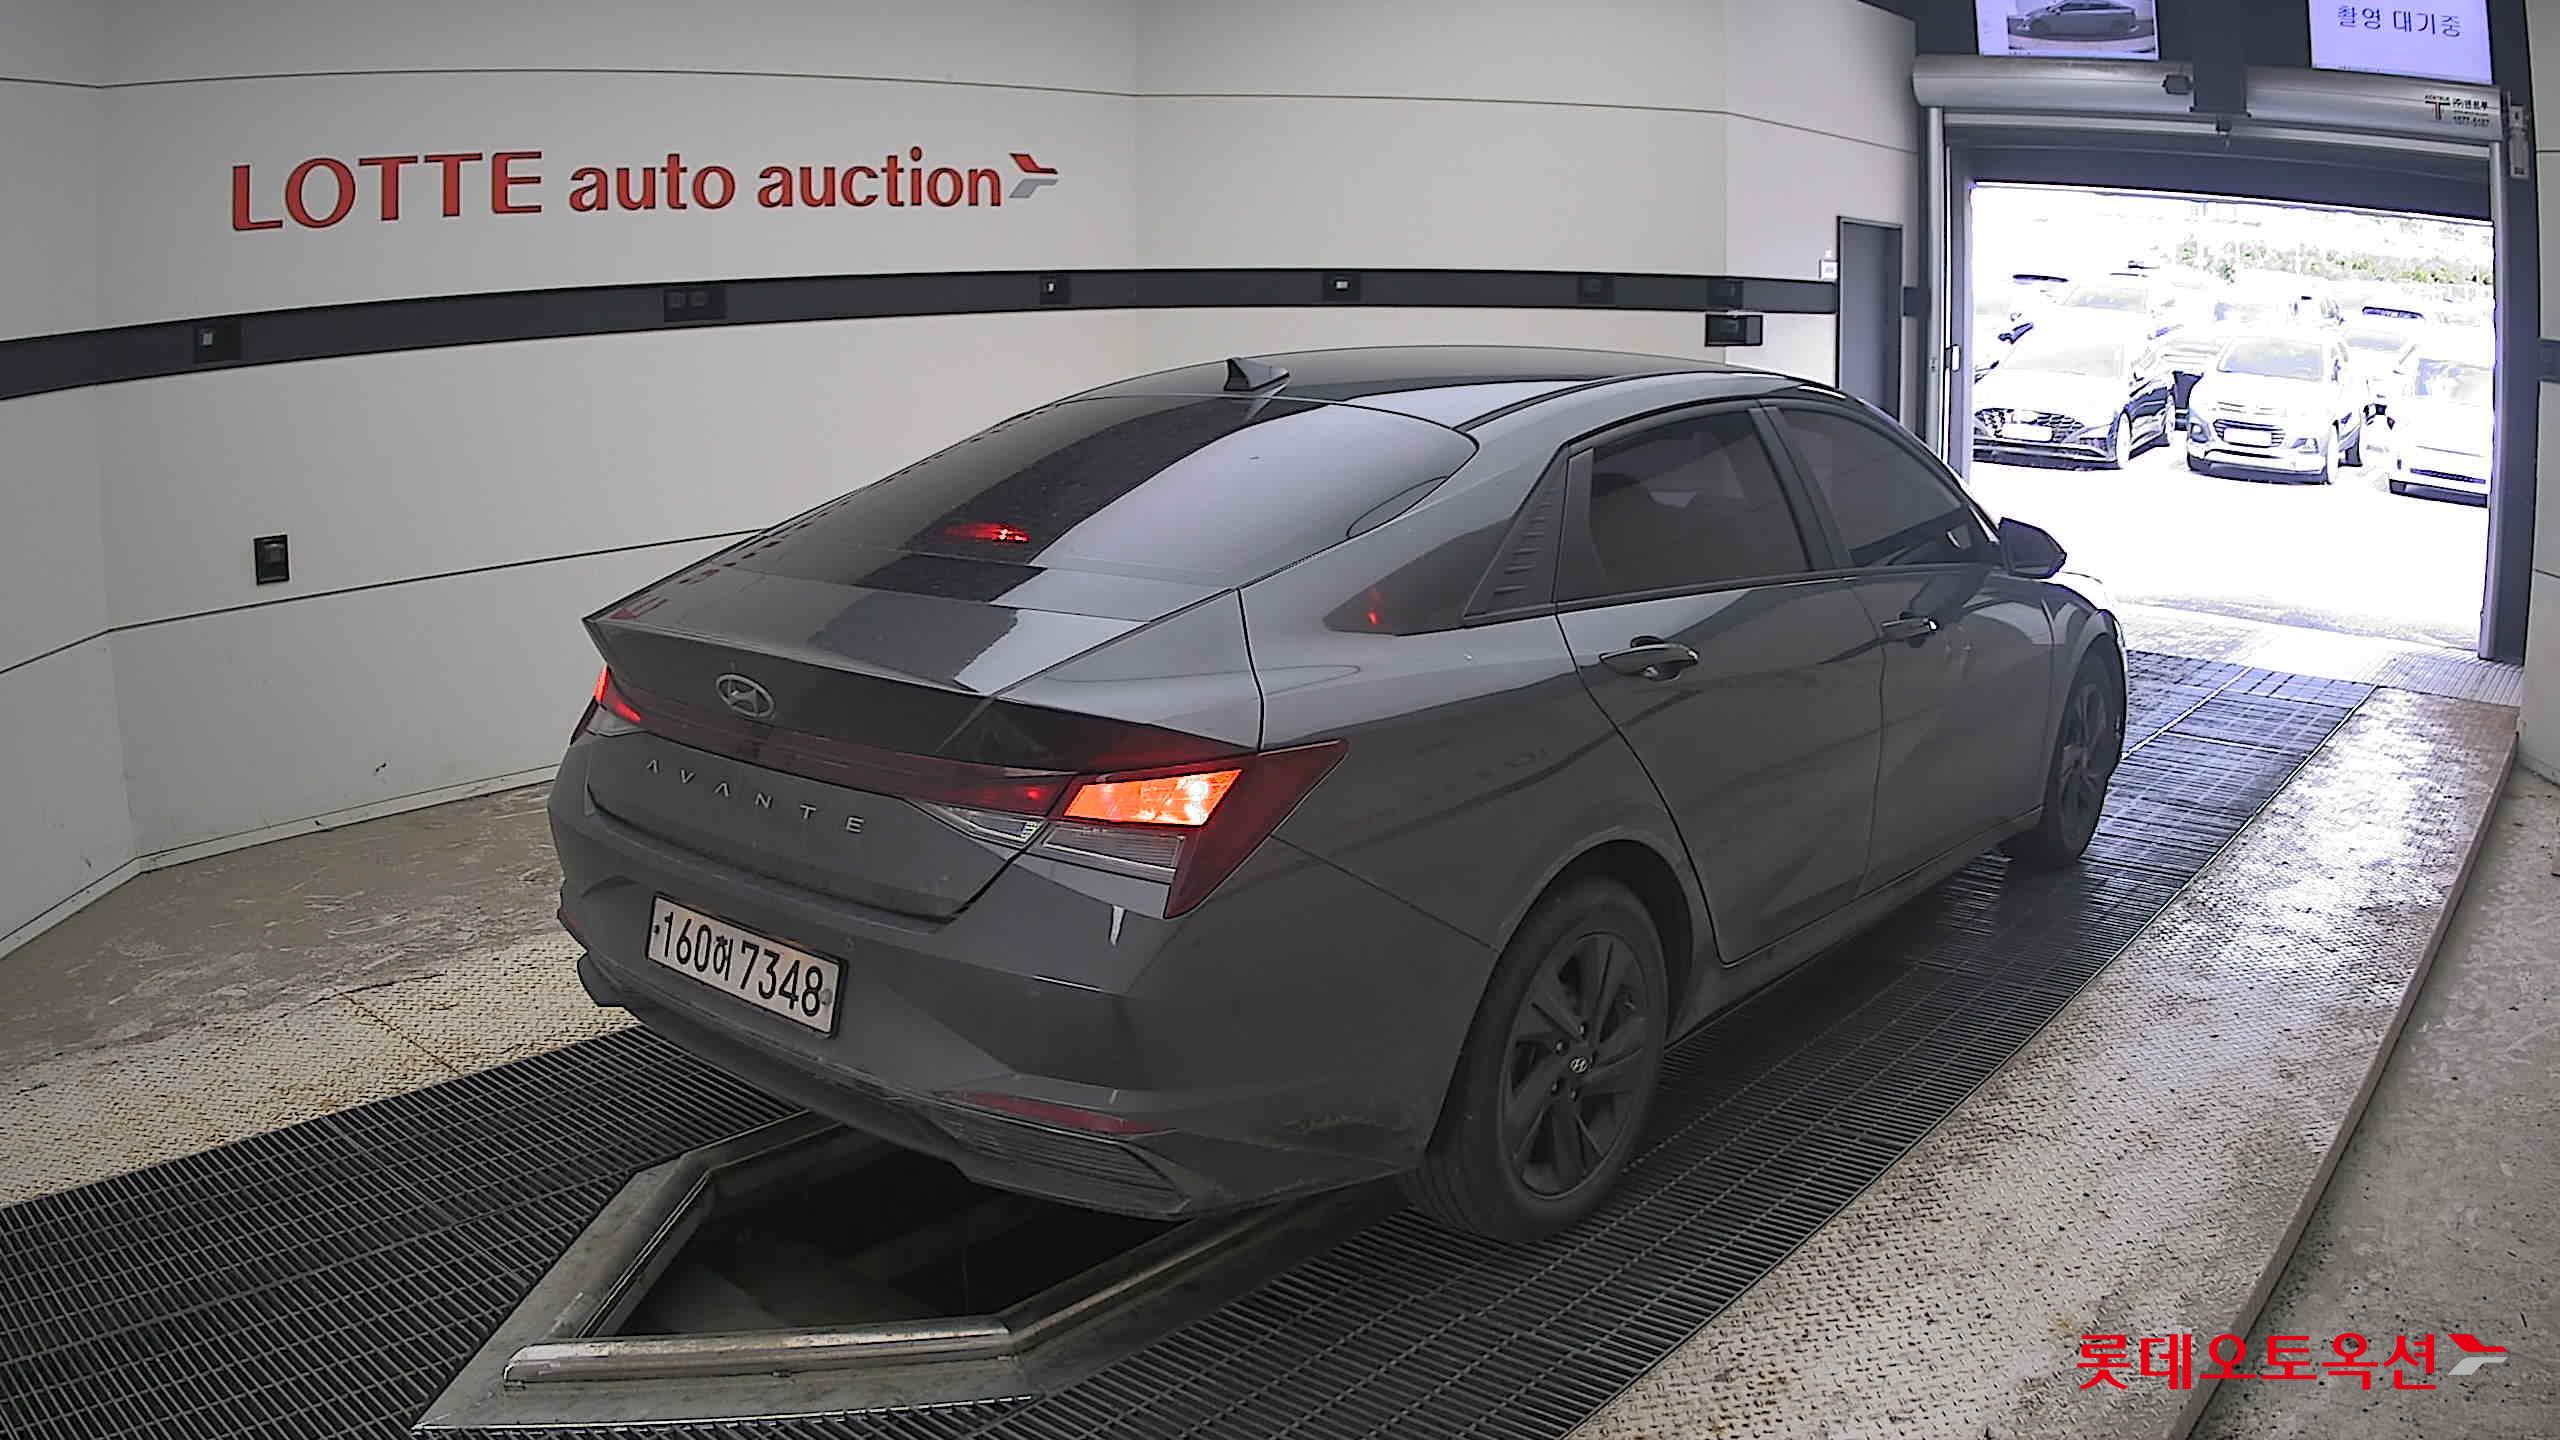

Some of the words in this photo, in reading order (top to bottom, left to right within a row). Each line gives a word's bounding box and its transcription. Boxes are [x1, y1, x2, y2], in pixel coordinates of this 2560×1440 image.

[2338, 5, 2381, 30] 촬영
[2393, 10, 2461, 37] 대기중
[232, 151, 543, 231] LOTTE
[569, 153, 735, 211] auto
[757, 146, 1001, 208] auction
[646, 758, 865, 834] AVANTE
